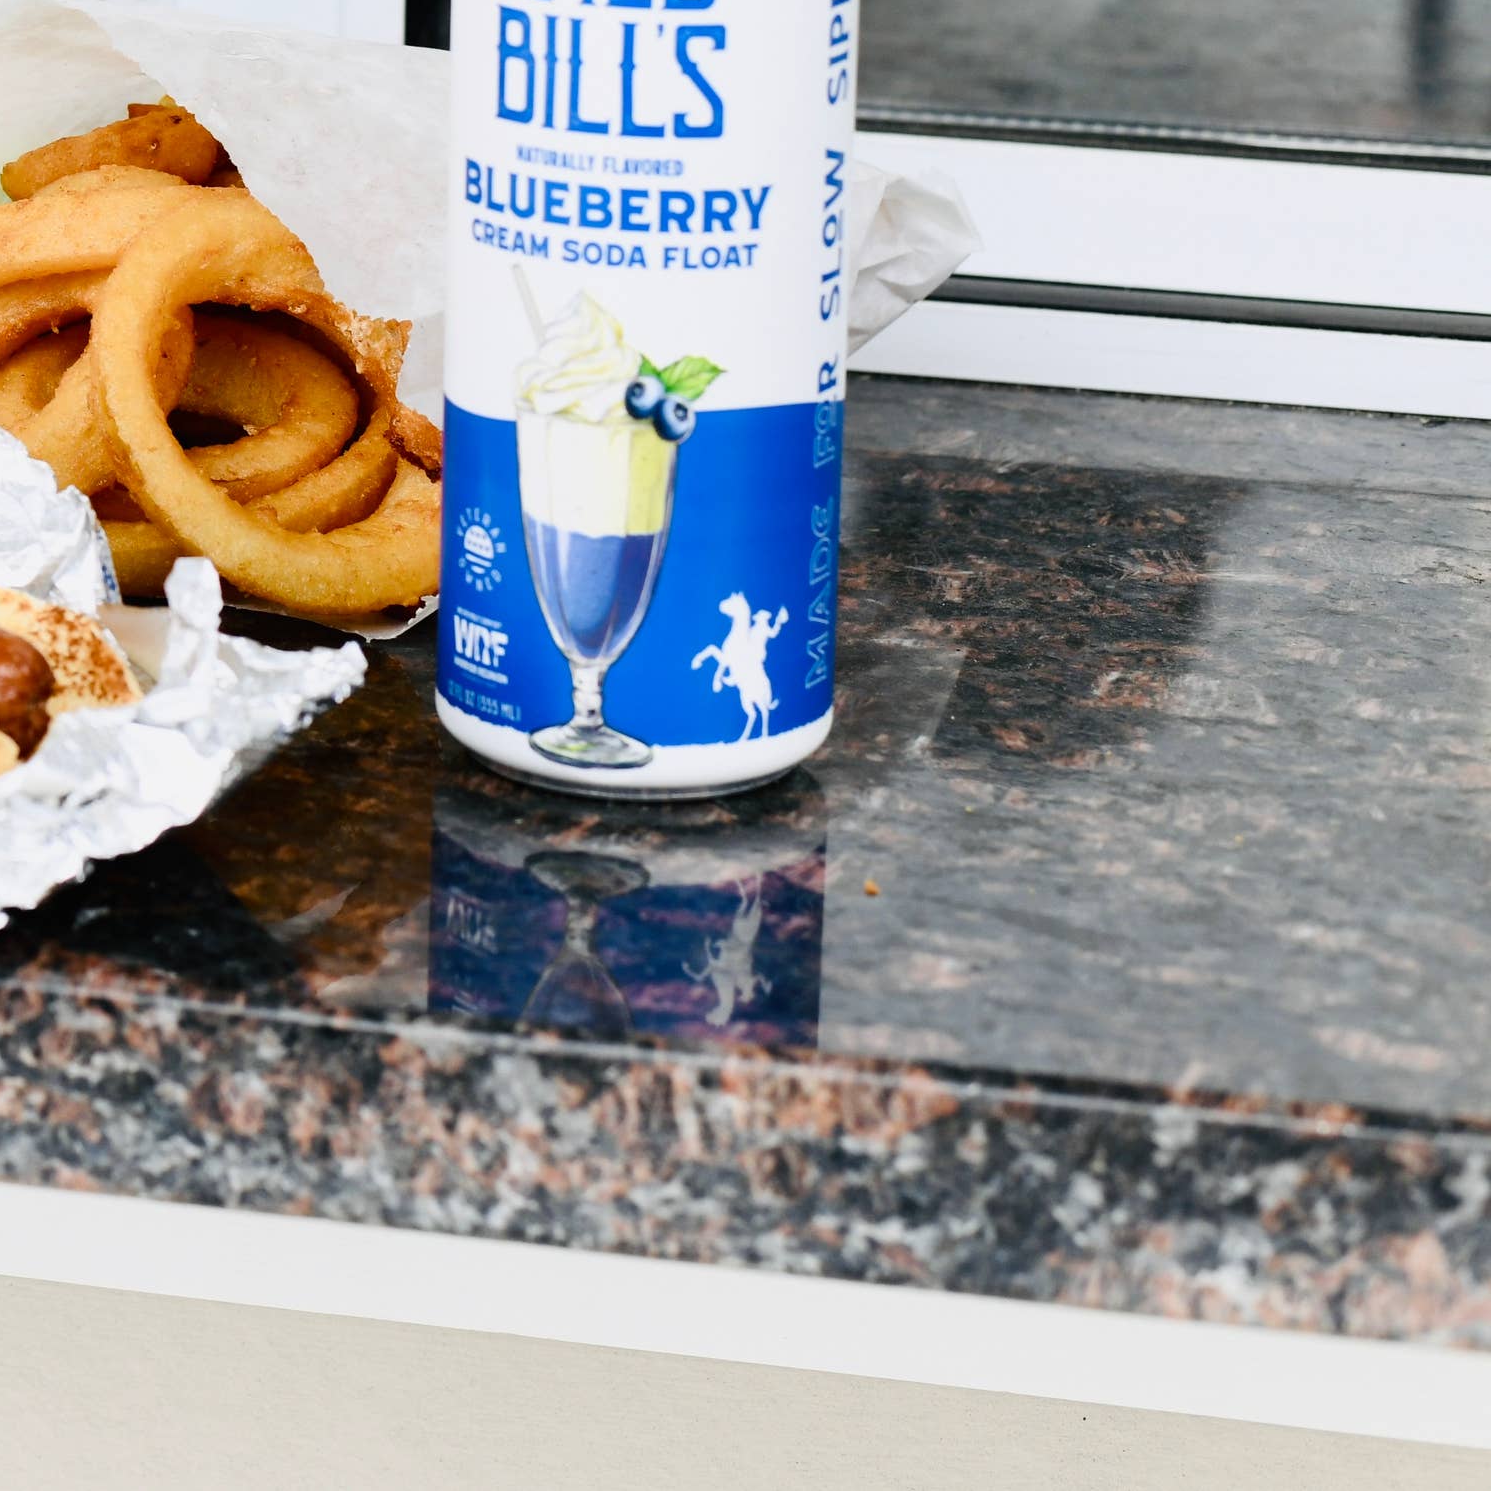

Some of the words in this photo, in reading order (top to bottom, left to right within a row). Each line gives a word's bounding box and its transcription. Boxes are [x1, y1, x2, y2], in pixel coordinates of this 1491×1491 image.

[496, 4, 726, 138] BILL'S
[465, 158, 771, 234] BLUEBERRY
[516, 144, 594, 171] NATURALLY
[602, 156, 684, 178] FLAVORED
[472, 219, 549, 259] CREAM
[563, 240, 647, 269] SODA
[663, 243, 758, 269] FLOAT
[820, 149, 846, 322] SLOW
